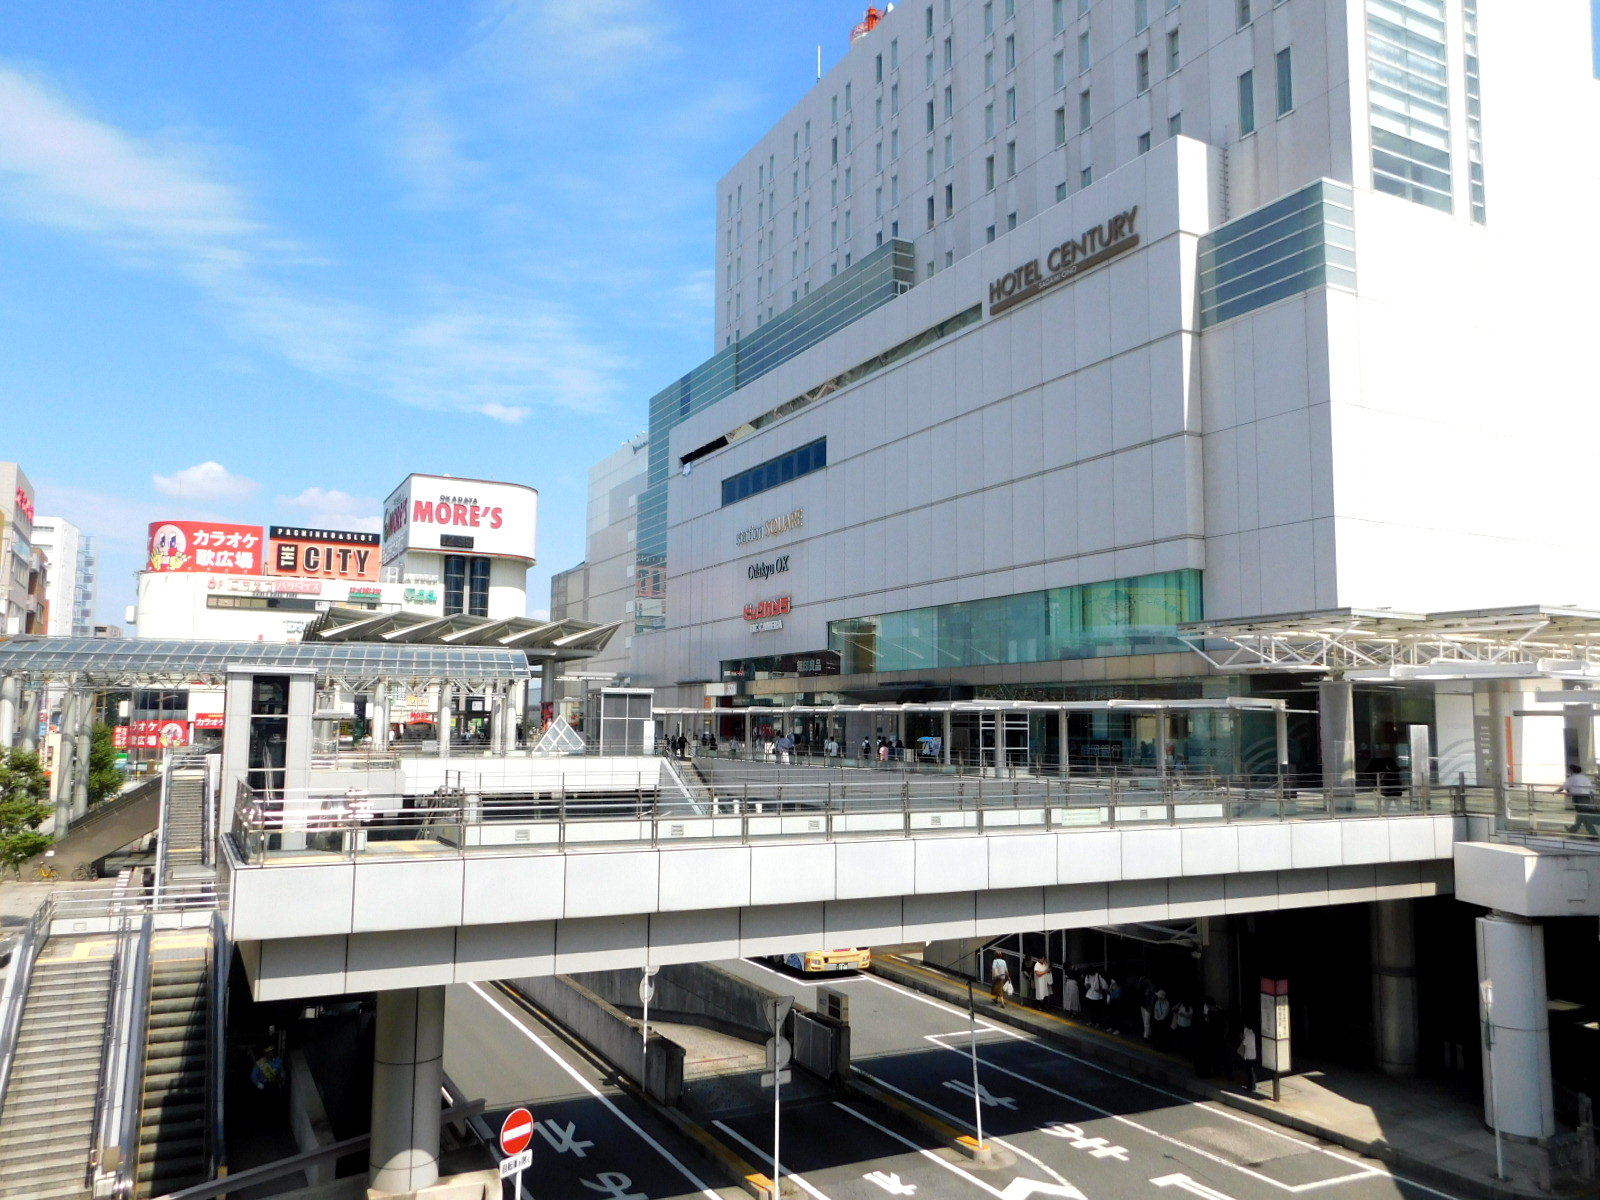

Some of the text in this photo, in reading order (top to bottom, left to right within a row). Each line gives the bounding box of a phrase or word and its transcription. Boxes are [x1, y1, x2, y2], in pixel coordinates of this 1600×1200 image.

[989, 205, 1138, 303] HOTEL CENTURY
[439, 494, 478, 506] OKADAYA
[413, 500, 503, 529] MORE'S
[736, 509, 803, 546] station SQUARE
[193, 530, 259, 549] カラオケ
[196, 549, 253, 569] 歌広場
[281, 546, 295, 567] THE
[303, 545, 371, 574] CITY
[776, 555, 790, 574] OX
[743, 597, 791, 621] ビックカメラ
